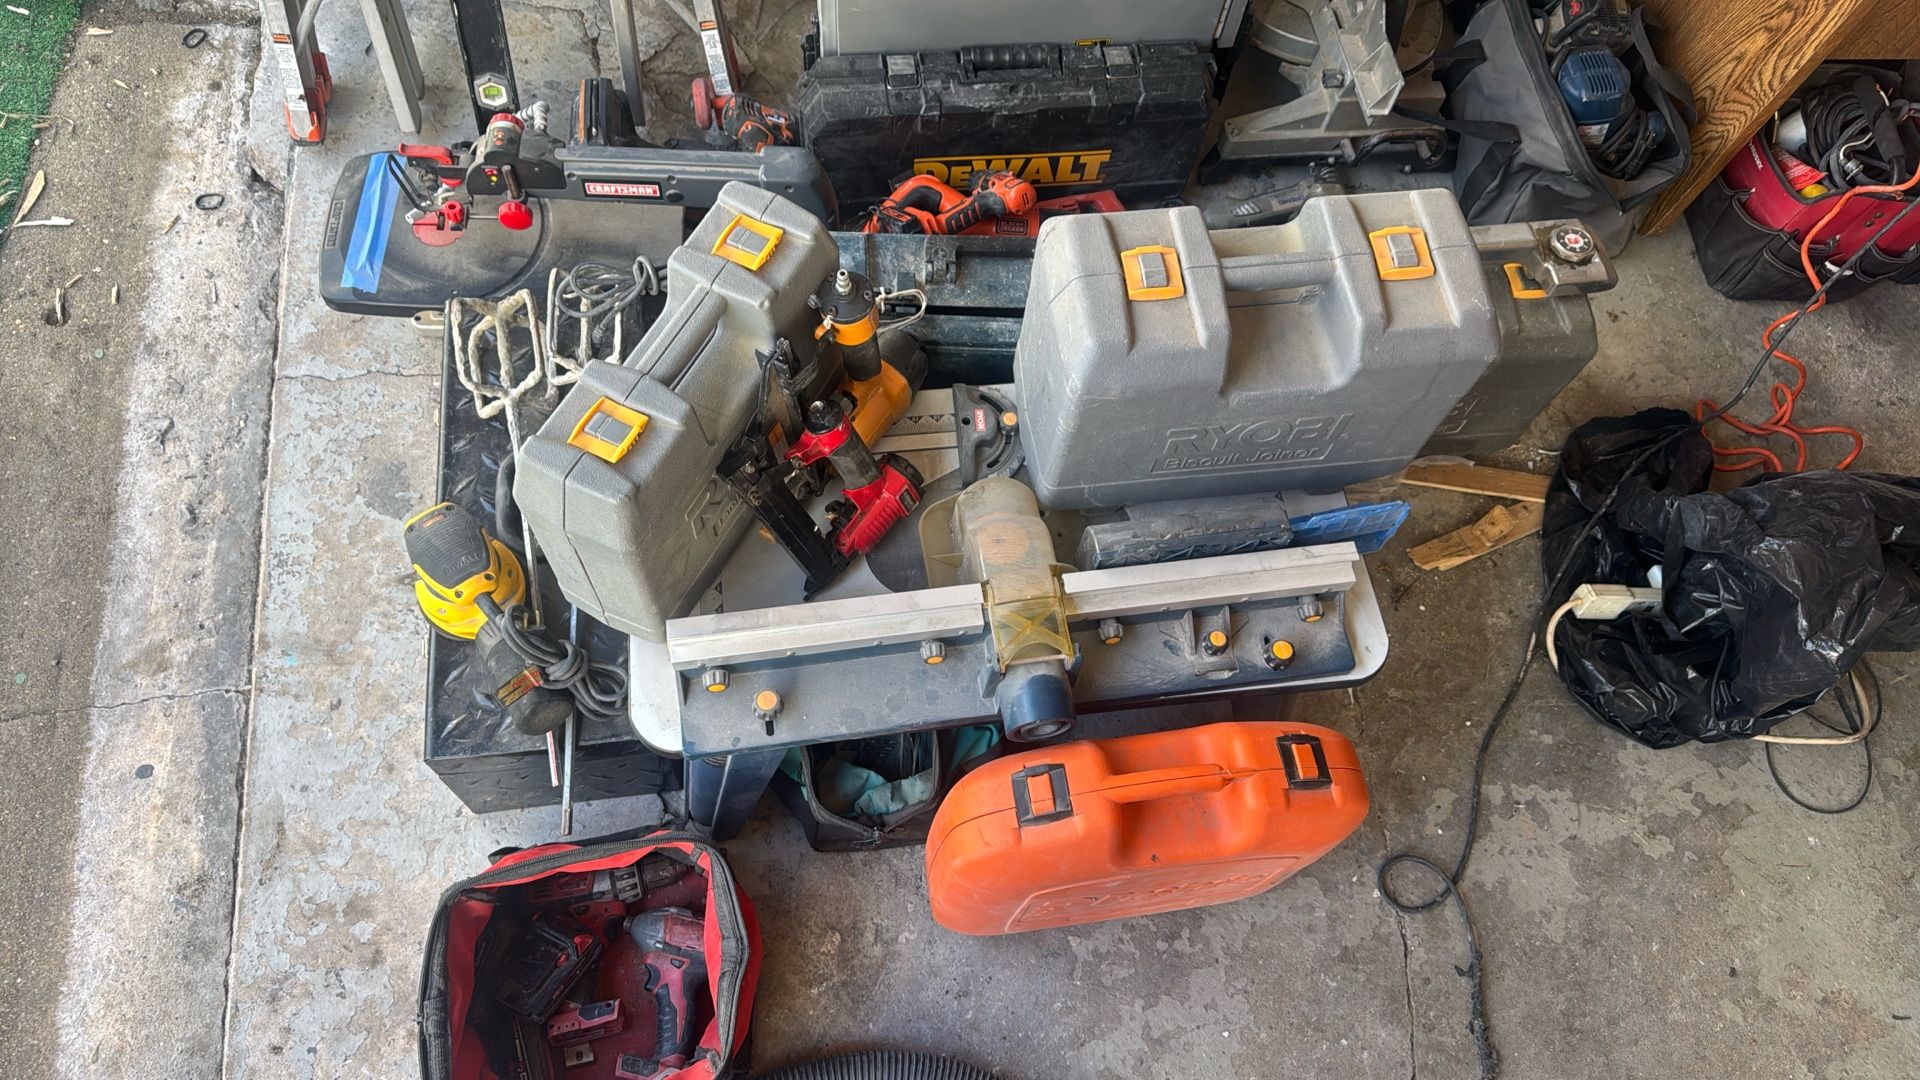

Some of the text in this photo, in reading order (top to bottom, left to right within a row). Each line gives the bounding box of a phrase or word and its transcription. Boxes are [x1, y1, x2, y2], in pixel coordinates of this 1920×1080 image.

[588, 184, 653, 196] CRAFTSMAN
[1164, 413, 1353, 455] RYOBI
[1164, 447, 1319, 469] Biscuit Joiner
